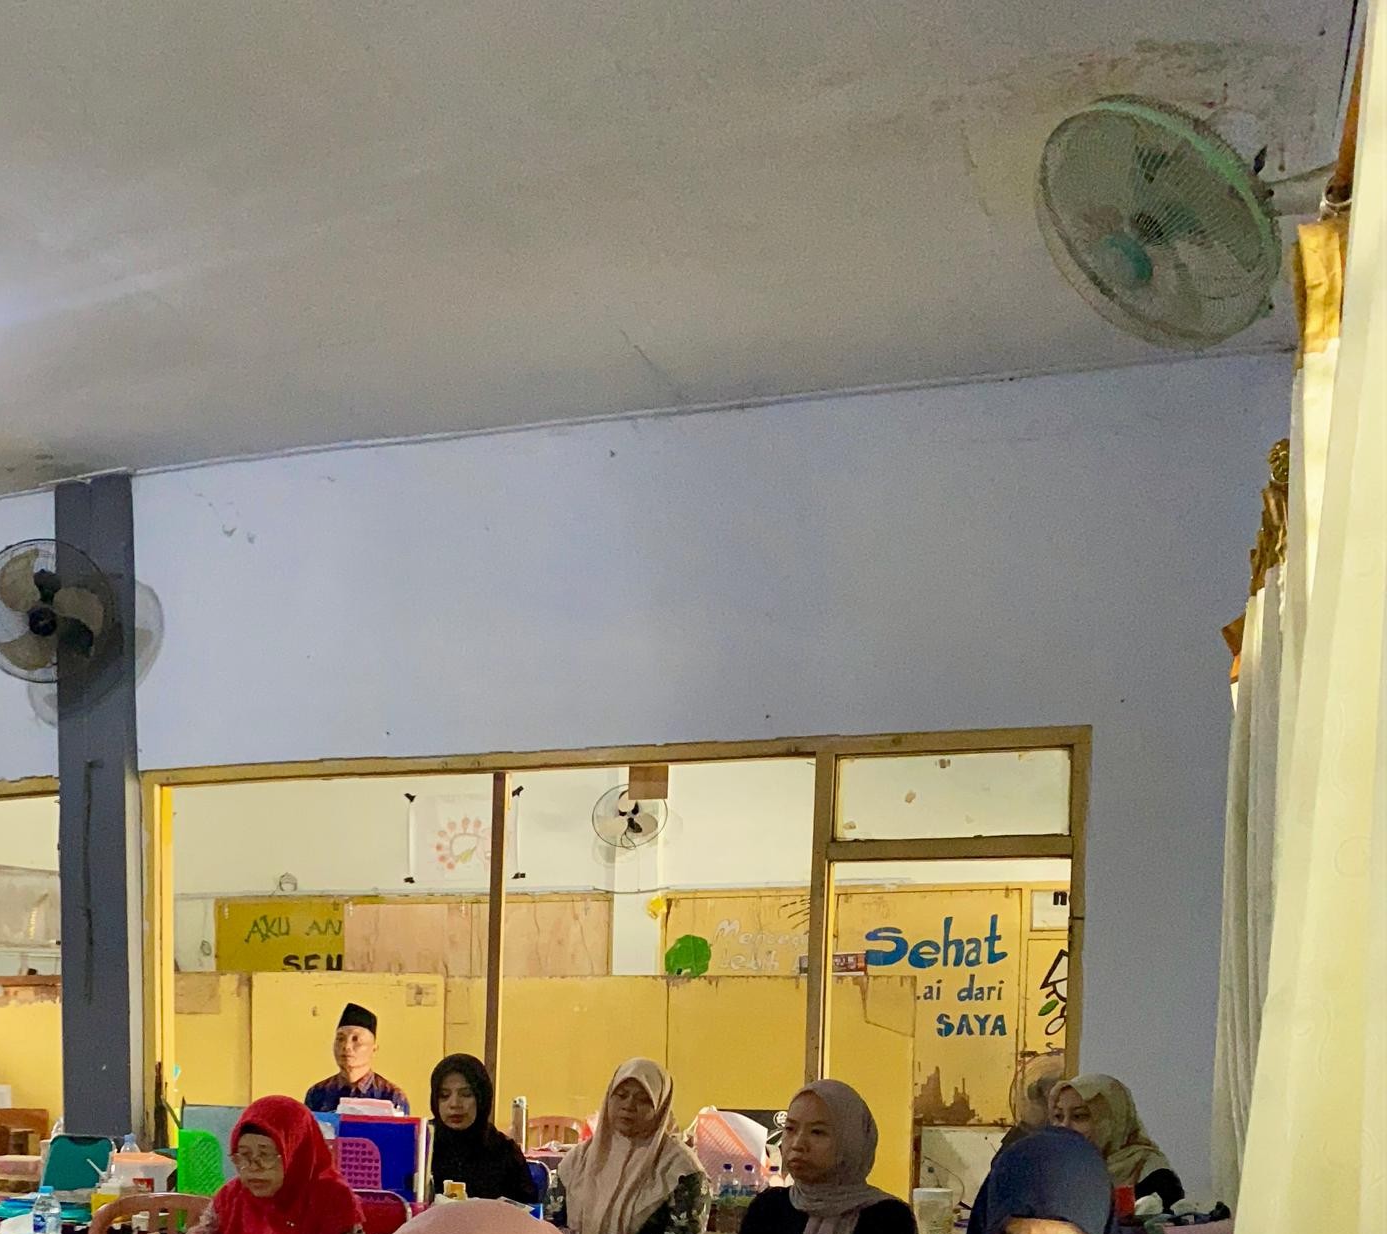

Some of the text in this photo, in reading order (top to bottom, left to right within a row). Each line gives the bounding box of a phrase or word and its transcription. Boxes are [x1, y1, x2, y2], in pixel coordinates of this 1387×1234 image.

[245, 915, 290, 943] AKU
[865, 914, 1008, 969] Sehat
[916, 974, 1004, 1002] ai dari
[936, 1013, 1007, 1037] SAYA
